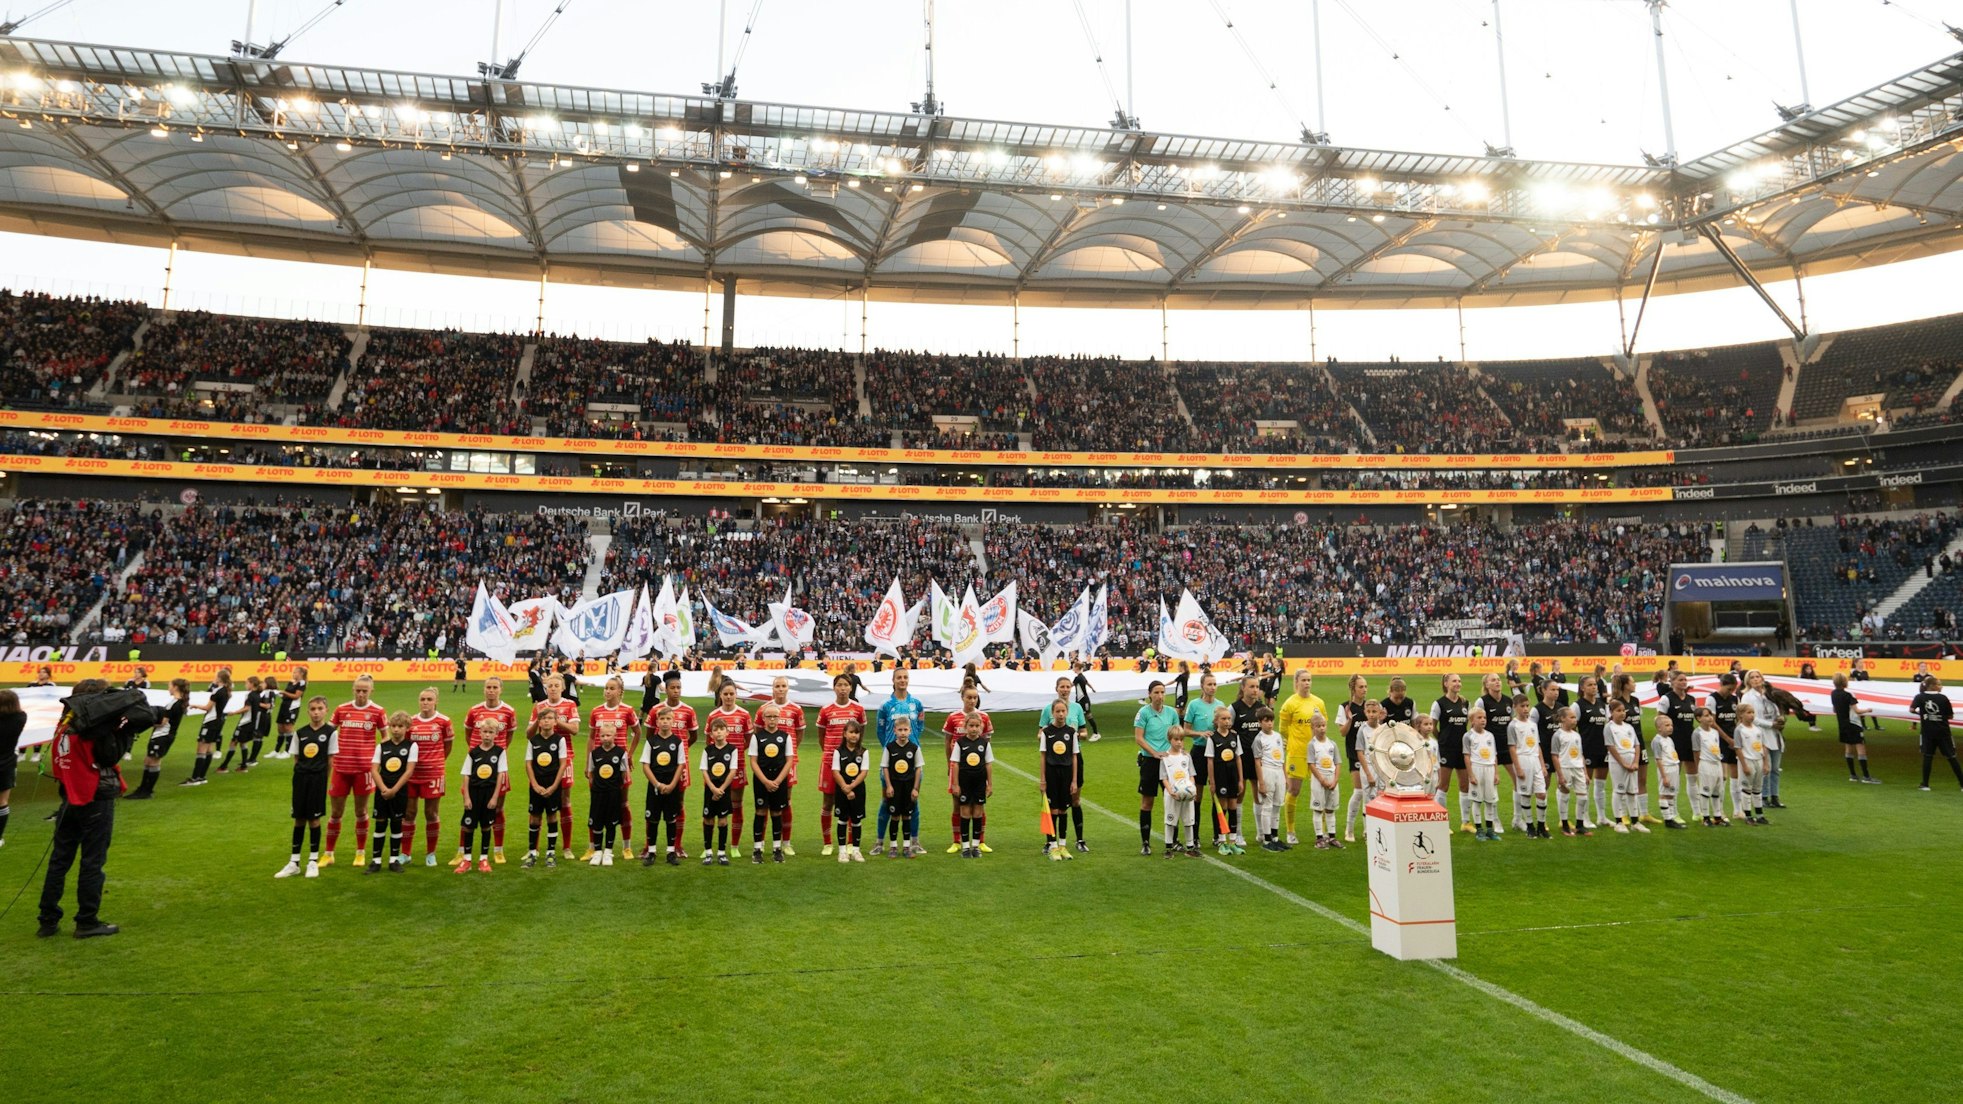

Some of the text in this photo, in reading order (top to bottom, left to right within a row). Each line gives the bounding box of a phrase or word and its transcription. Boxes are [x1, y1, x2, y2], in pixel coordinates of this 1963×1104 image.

[54, 415, 84, 424] LOTTO
[119, 419, 148, 427] LOTTO
[181, 422, 210, 430] LOTTO
[242, 425, 270, 434] LOTTO
[10, 457, 41, 465] LOTTO
[78, 460, 108, 468] LOTTO
[1880, 472, 1922, 486] indeed
[1775, 482, 1816, 494] indeed
[1675, 488, 1714, 499] indeed
[539, 505, 667, 518] Deutsche Bank Park
[954, 514, 979, 523] Bank
[1000, 514, 1021, 523] Park
[1694, 576, 1776, 587] mainova
[1816, 646, 1863, 658] indeed
[348, 663, 384, 672] LOTTO
[422, 663, 456, 672] LOTTO
[495, 663, 529, 672] LOTTO
[1394, 813, 1448, 822] FLYERALARM
